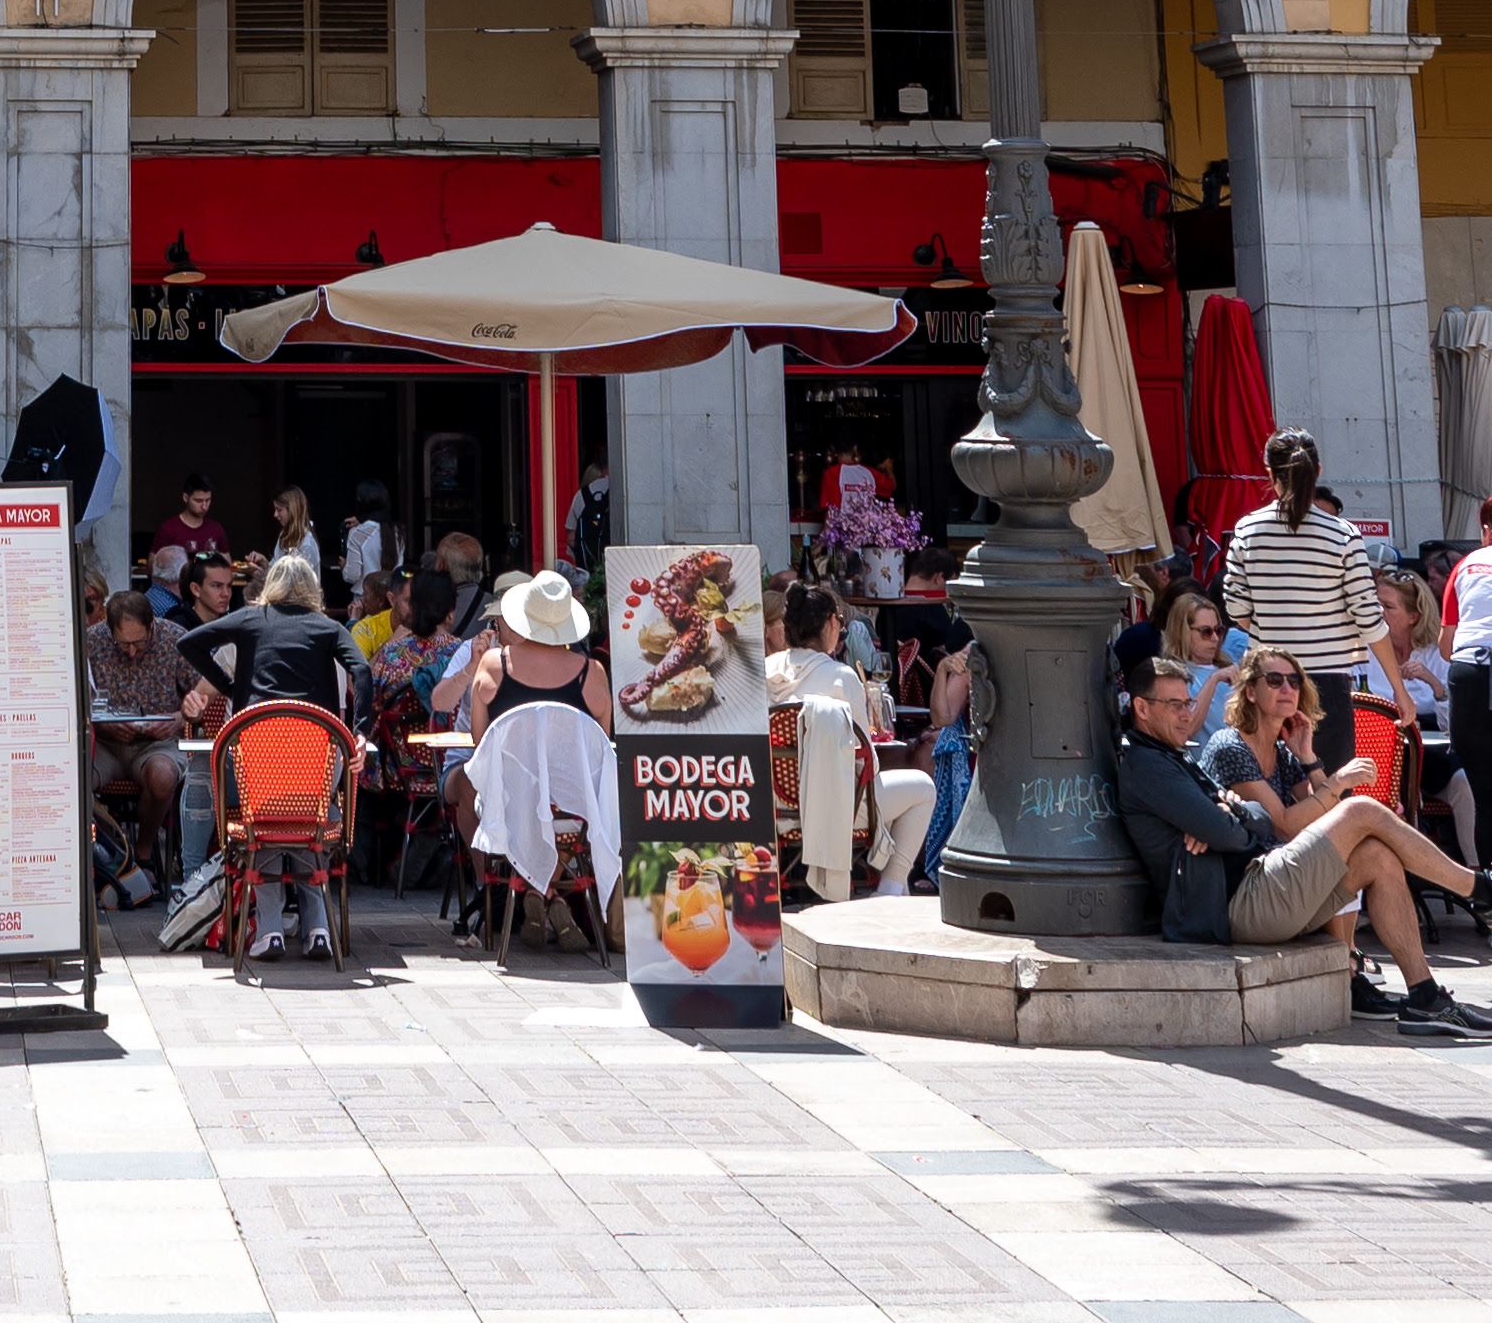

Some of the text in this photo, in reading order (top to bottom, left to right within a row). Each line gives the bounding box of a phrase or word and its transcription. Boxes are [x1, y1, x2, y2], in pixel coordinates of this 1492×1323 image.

[6, 508, 51, 523] MAYOR
[634, 755, 756, 787] BODEGA
[644, 789, 751, 821] MAYOR
